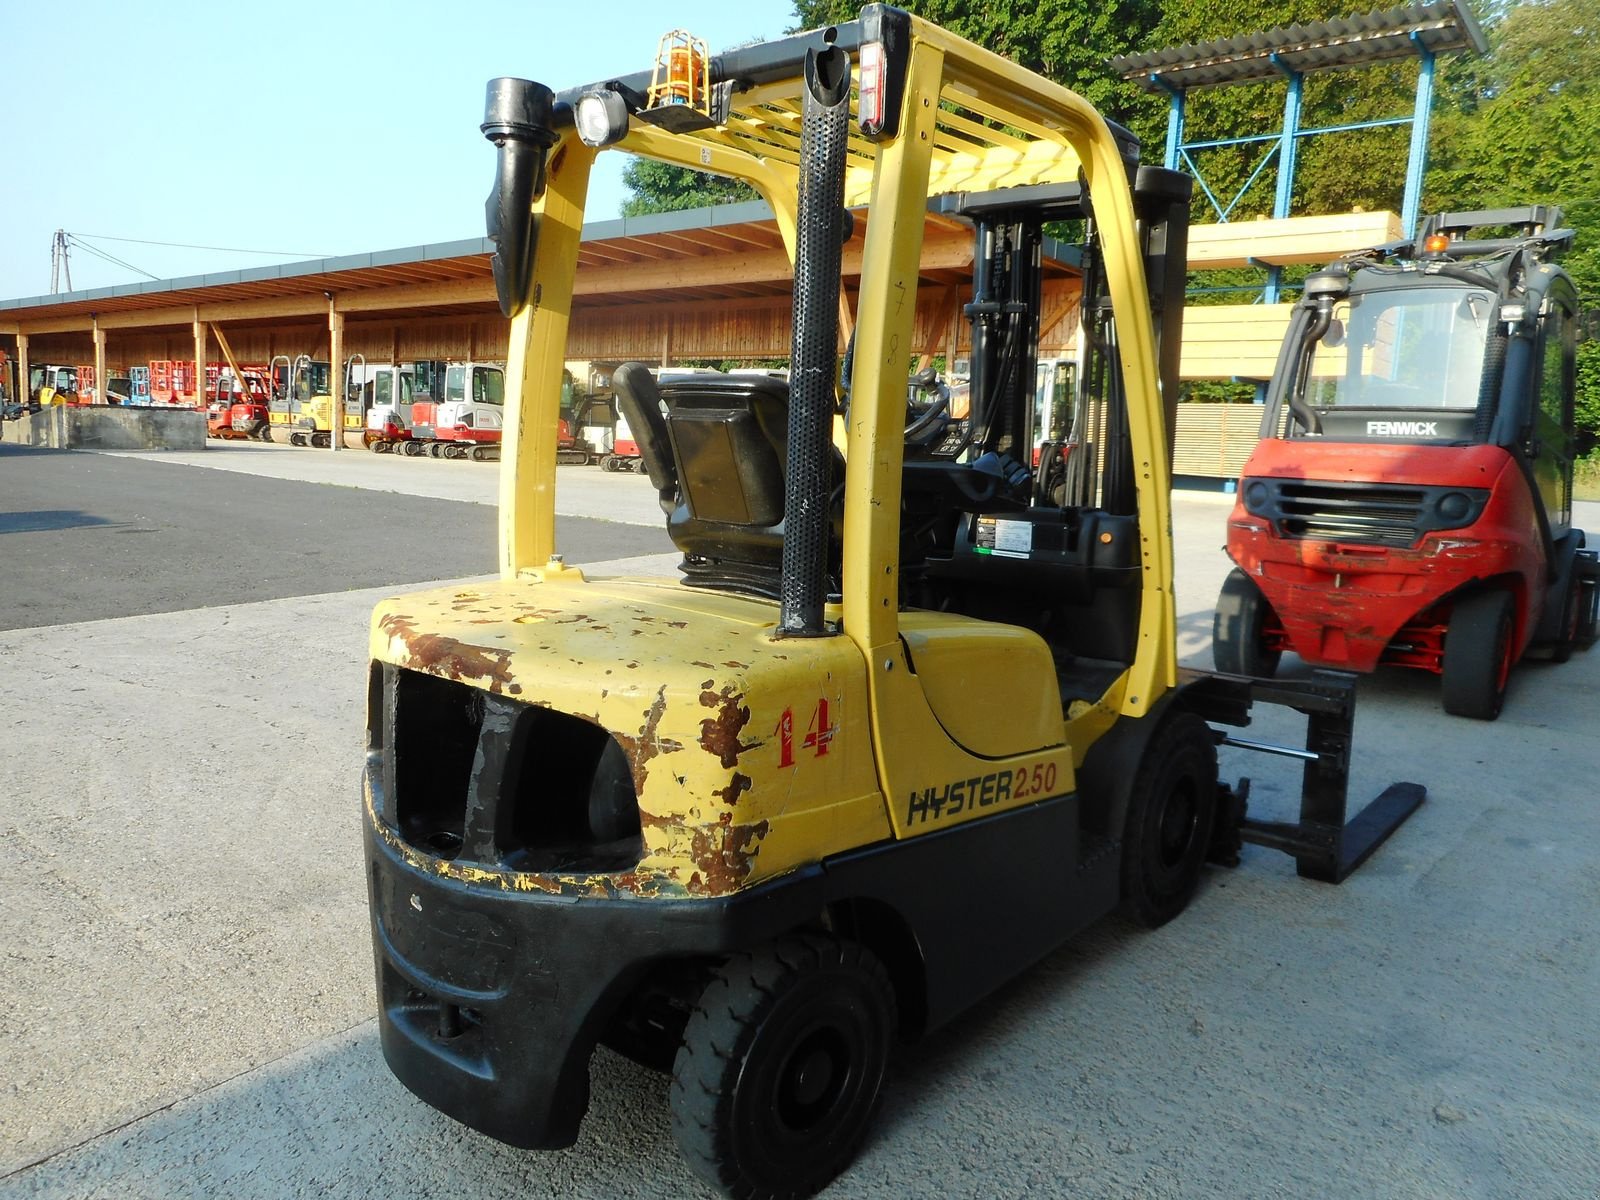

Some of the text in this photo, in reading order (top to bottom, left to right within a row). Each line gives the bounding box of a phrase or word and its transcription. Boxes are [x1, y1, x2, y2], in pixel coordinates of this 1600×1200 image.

[1366, 421, 1438, 436] FENWICK
[774, 698, 833, 769] 14
[907, 762, 1058, 826] HYSTER 2.50
